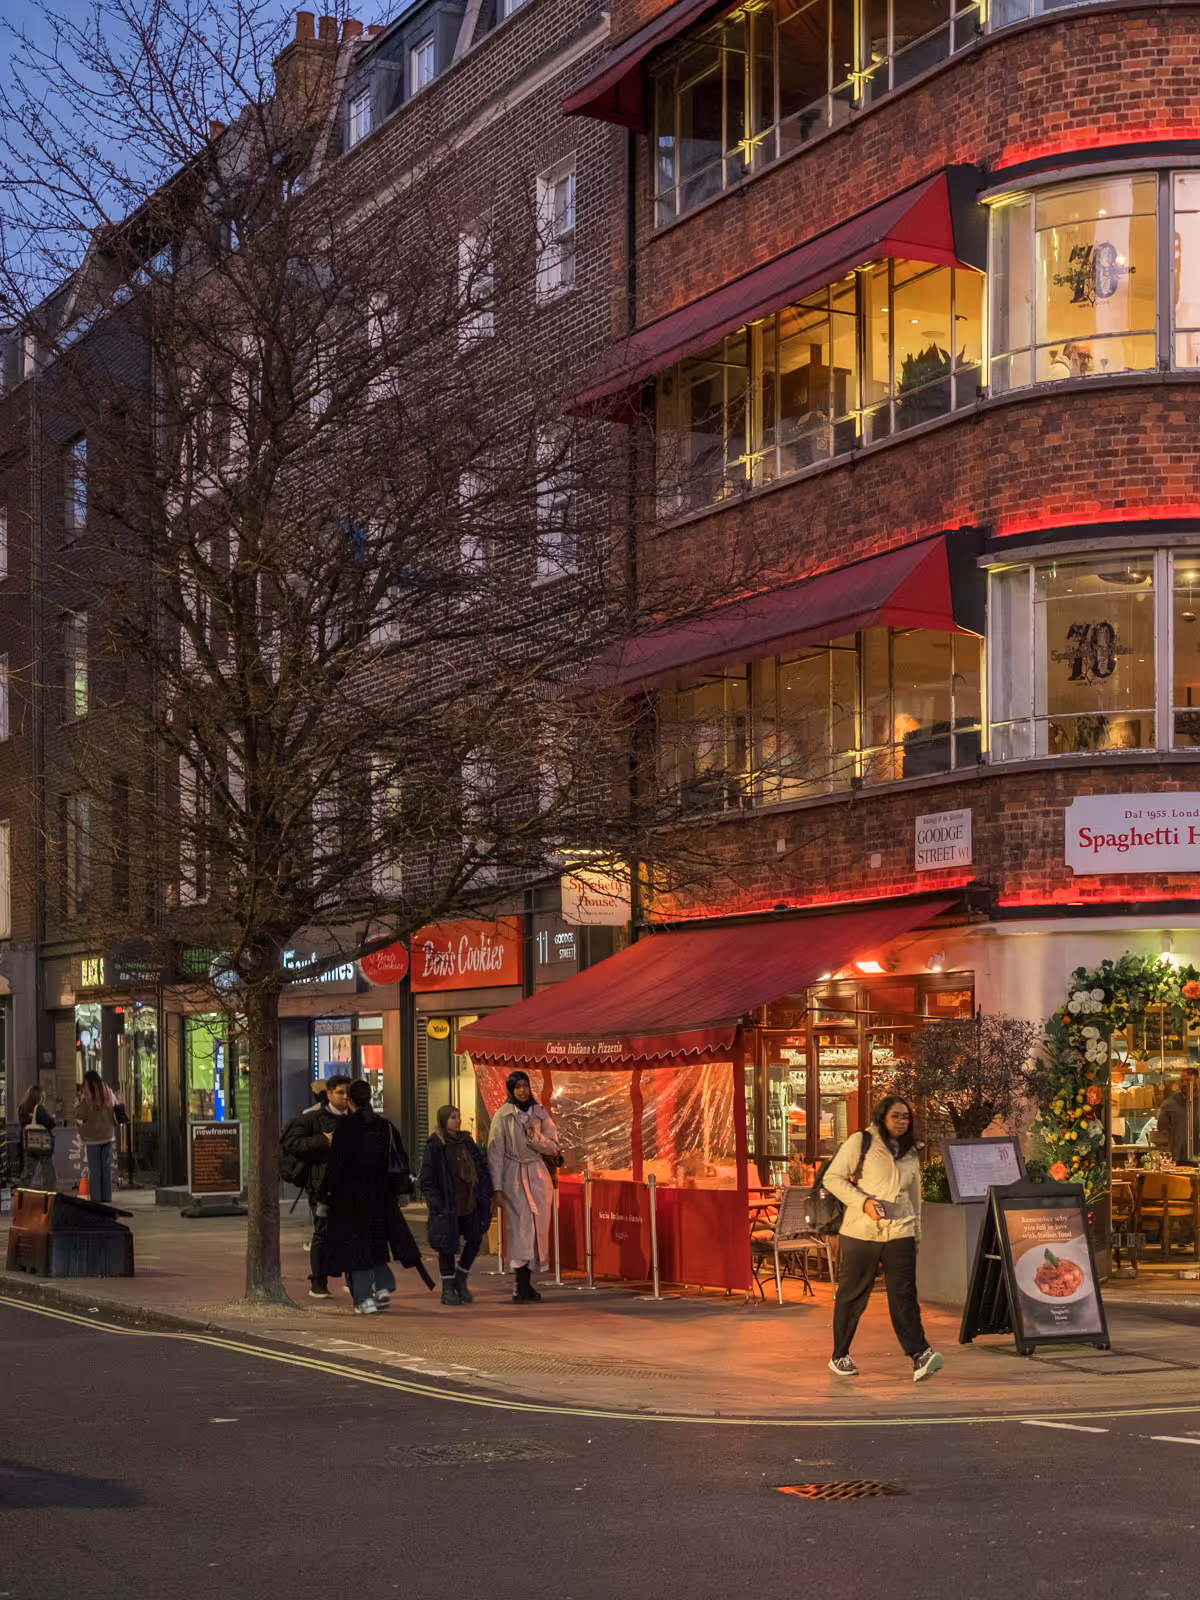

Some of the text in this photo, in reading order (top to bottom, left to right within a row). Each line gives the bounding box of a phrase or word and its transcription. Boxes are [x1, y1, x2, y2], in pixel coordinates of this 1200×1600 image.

[1124, 810, 1142, 819] Dal
[917, 825, 963, 845] GOODGE
[1078, 827, 1180, 853] Spaghetti
[917, 846, 956, 865] STREET
[554, 932, 574, 944] GOODGE
[422, 932, 504, 977] Ben's Cookies
[537, 930, 548, 964] 11
[559, 947, 574, 959] STREET
[546, 1041, 622, 1054] Cucina Italiana e Pizzeria
[196, 1127, 237, 1136] newframes
